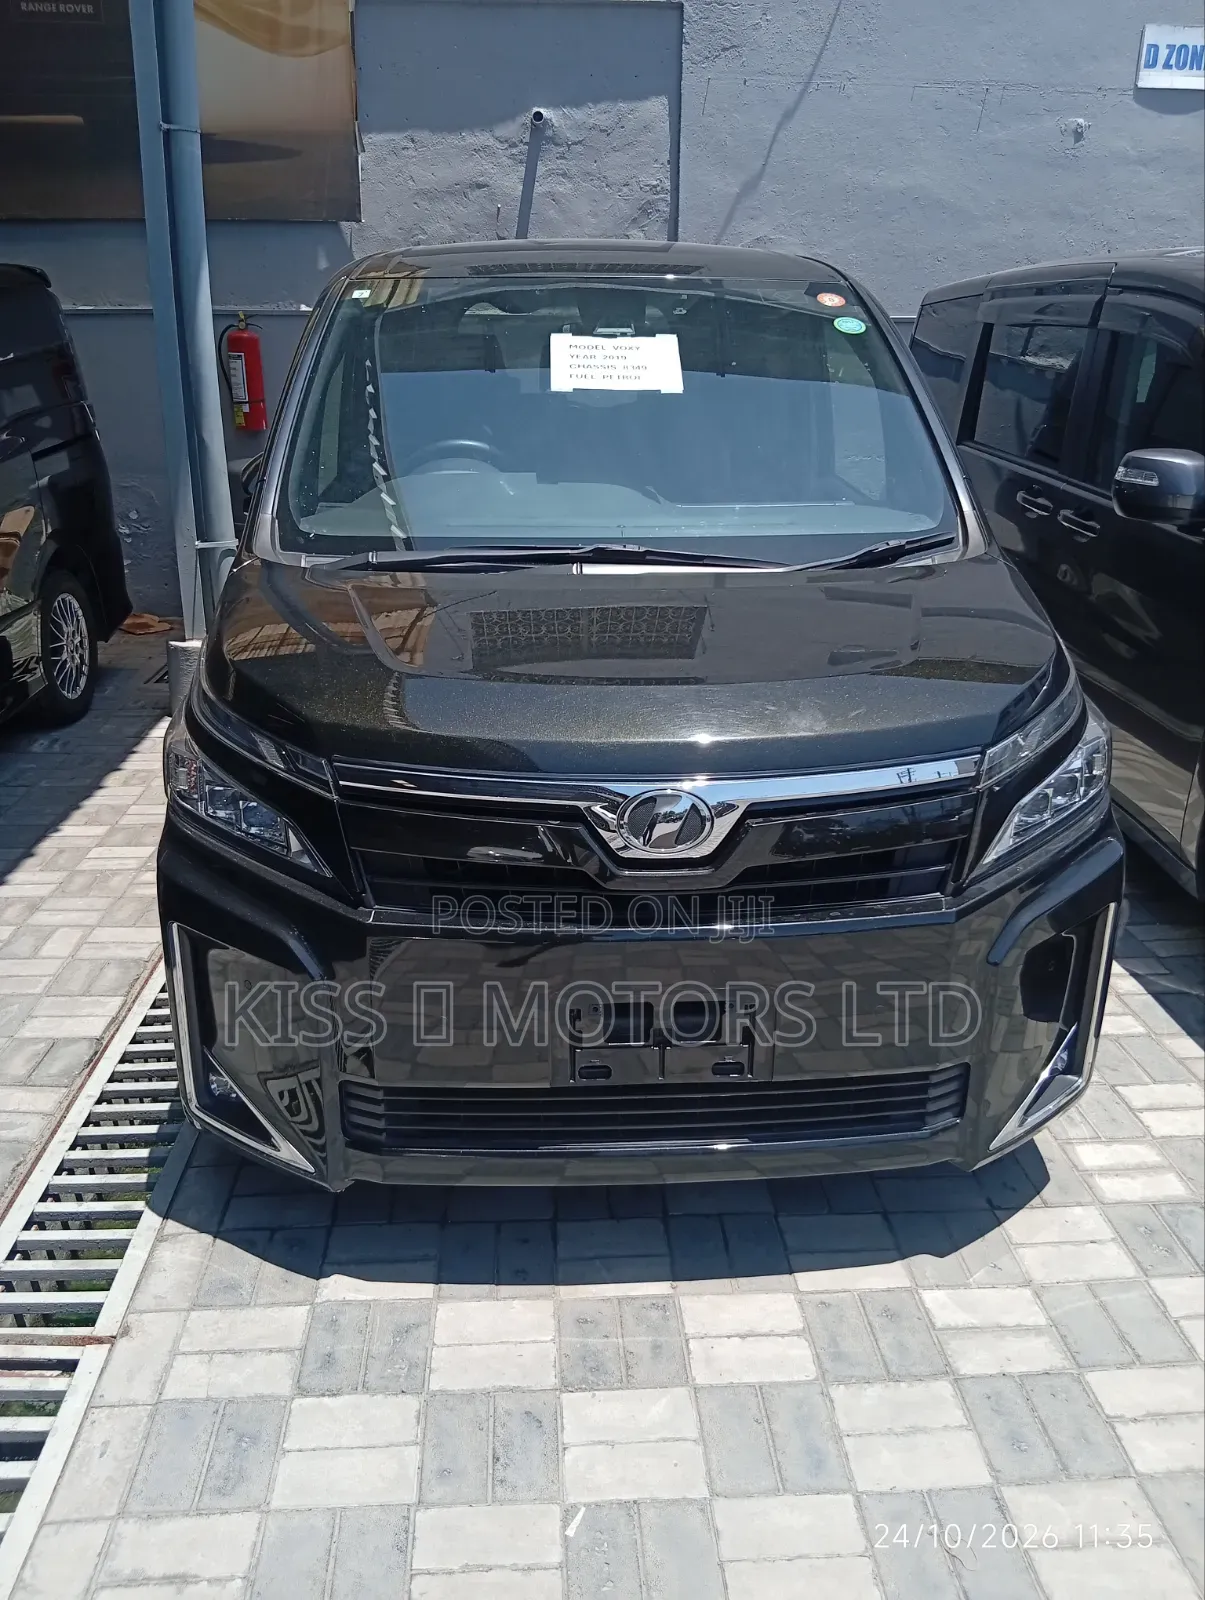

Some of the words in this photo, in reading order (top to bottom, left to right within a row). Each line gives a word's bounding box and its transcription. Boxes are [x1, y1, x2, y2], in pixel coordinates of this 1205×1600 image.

[20, 2, 57, 13] RANGE
[60, 3, 94, 14] ROVER
[1144, 44, 1159, 69] D
[1162, 44, 1205, 70] ZON
